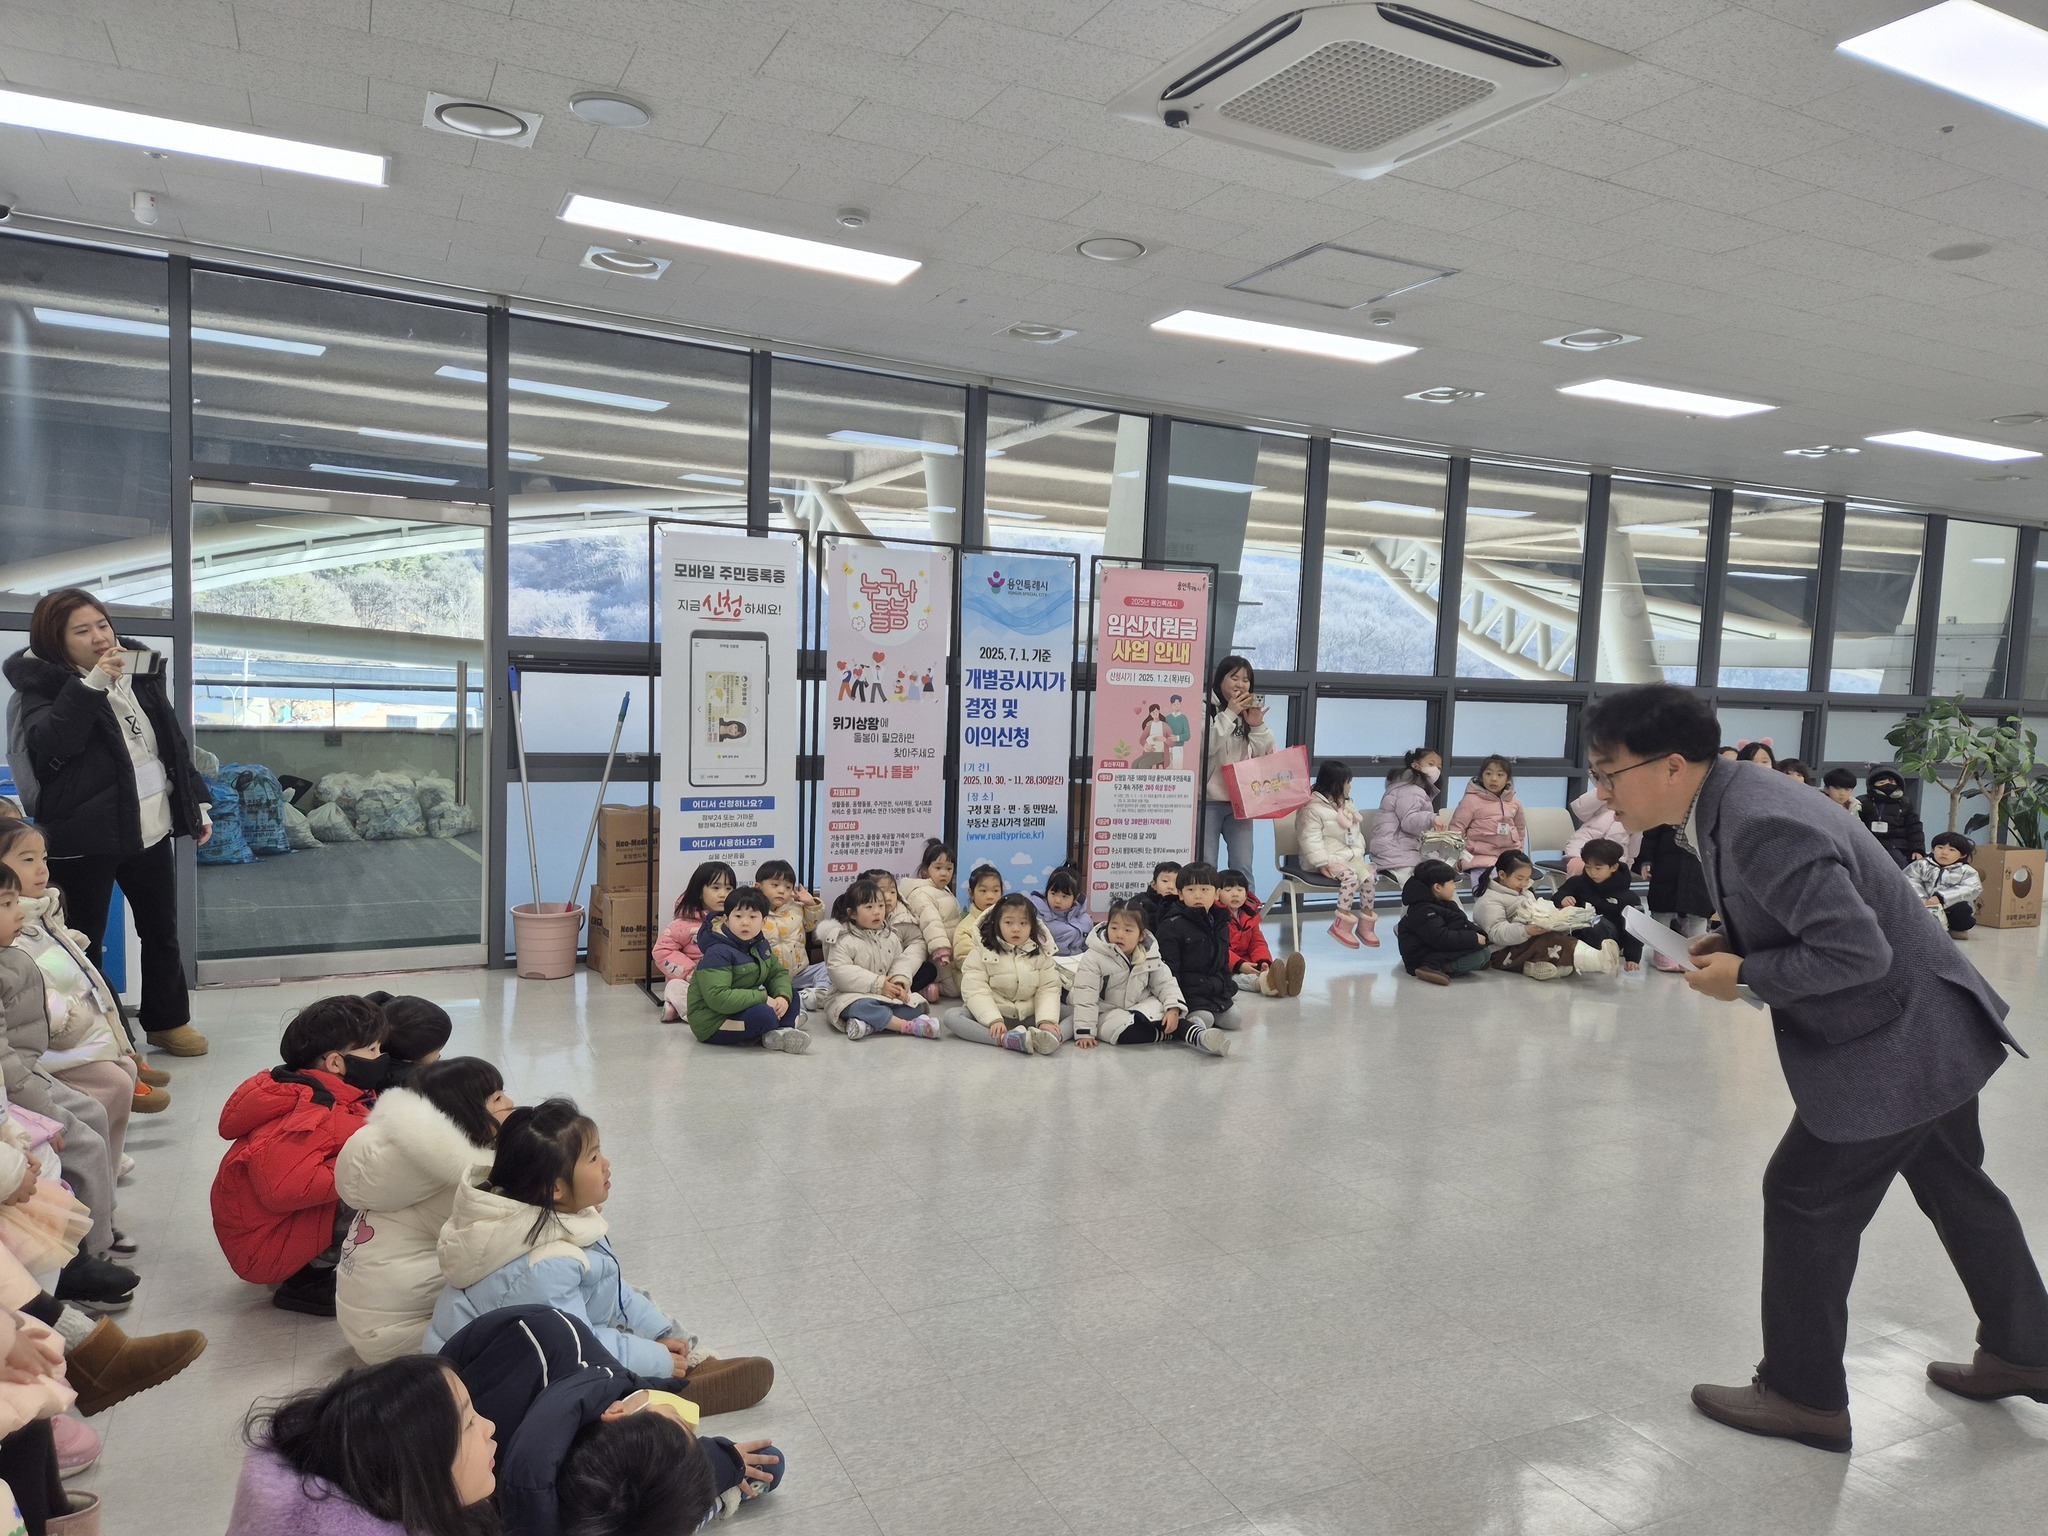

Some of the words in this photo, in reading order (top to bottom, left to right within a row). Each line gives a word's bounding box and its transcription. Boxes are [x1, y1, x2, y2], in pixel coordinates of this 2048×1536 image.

[674, 563, 715, 579] 모바일
[719, 566, 785, 583] 주민등록증
[860, 568, 918, 604] 누구나
[1007, 578, 1049, 591] 용인특례시
[678, 599, 701, 612] 지금
[1131, 598, 1150, 606] 2025년
[869, 598, 909, 634] 돌봄
[1107, 614, 1199, 640] 임신지원금
[980, 646, 1007, 661] 2025.
[1009, 648, 1018, 661] 7.
[1021, 649, 1030, 662] 1.
[1032, 649, 1052, 663] 기준
[1111, 639, 1150, 663] 사업
[1154, 641, 1191, 665] 안내
[965, 668, 1067, 692] 개별공시지가
[1109, 672, 1133, 682] 신청시기
[1138, 673, 1156, 683] 2025.
[965, 697, 997, 719] 결정
[1002, 698, 1018, 719] 및
[833, 716, 889, 730] 위기상황에
[853, 732, 879, 743] 돌봄이
[882, 732, 915, 744] 필요하면
[964, 726, 1029, 748] 이의신청
[893, 747, 935, 758] 찾아주세요
[963, 776, 982, 785] 2025.
[983, 776, 994, 785] 10.
[995, 776, 1006, 785] 30.
[1014, 776, 1024, 785] 11.
[832, 788, 857, 797] 지원내용
[693, 800, 717, 809] 어디서
[719, 799, 763, 809] 신청하나요?
[967, 805, 982, 815] 구청
[983, 804, 991, 815] 및
[993, 804, 1001, 815] 읍
[1008, 804, 1016, 814] 면
[1023, 804, 1031, 814] 동
[1032, 804, 1058, 814] 민원실,
[831, 822, 856, 830] 지원대상
[967, 818, 989, 828] 부동산
[991, 817, 1021, 828] 공시가격
[1022, 817, 1046, 827] 알리미
[966, 830, 1044, 841] (www.realtyprice.kr)
[1112, 832, 1127, 840] 신청한
[1127, 832, 1138, 840] 다음
[1139, 832, 1144, 840] 달
[1145, 832, 1157, 840] 20일
[615, 837, 658, 847] Neo-Medial
[692, 839, 716, 848] 어디서
[718, 838, 763, 847] 사용하나요?
